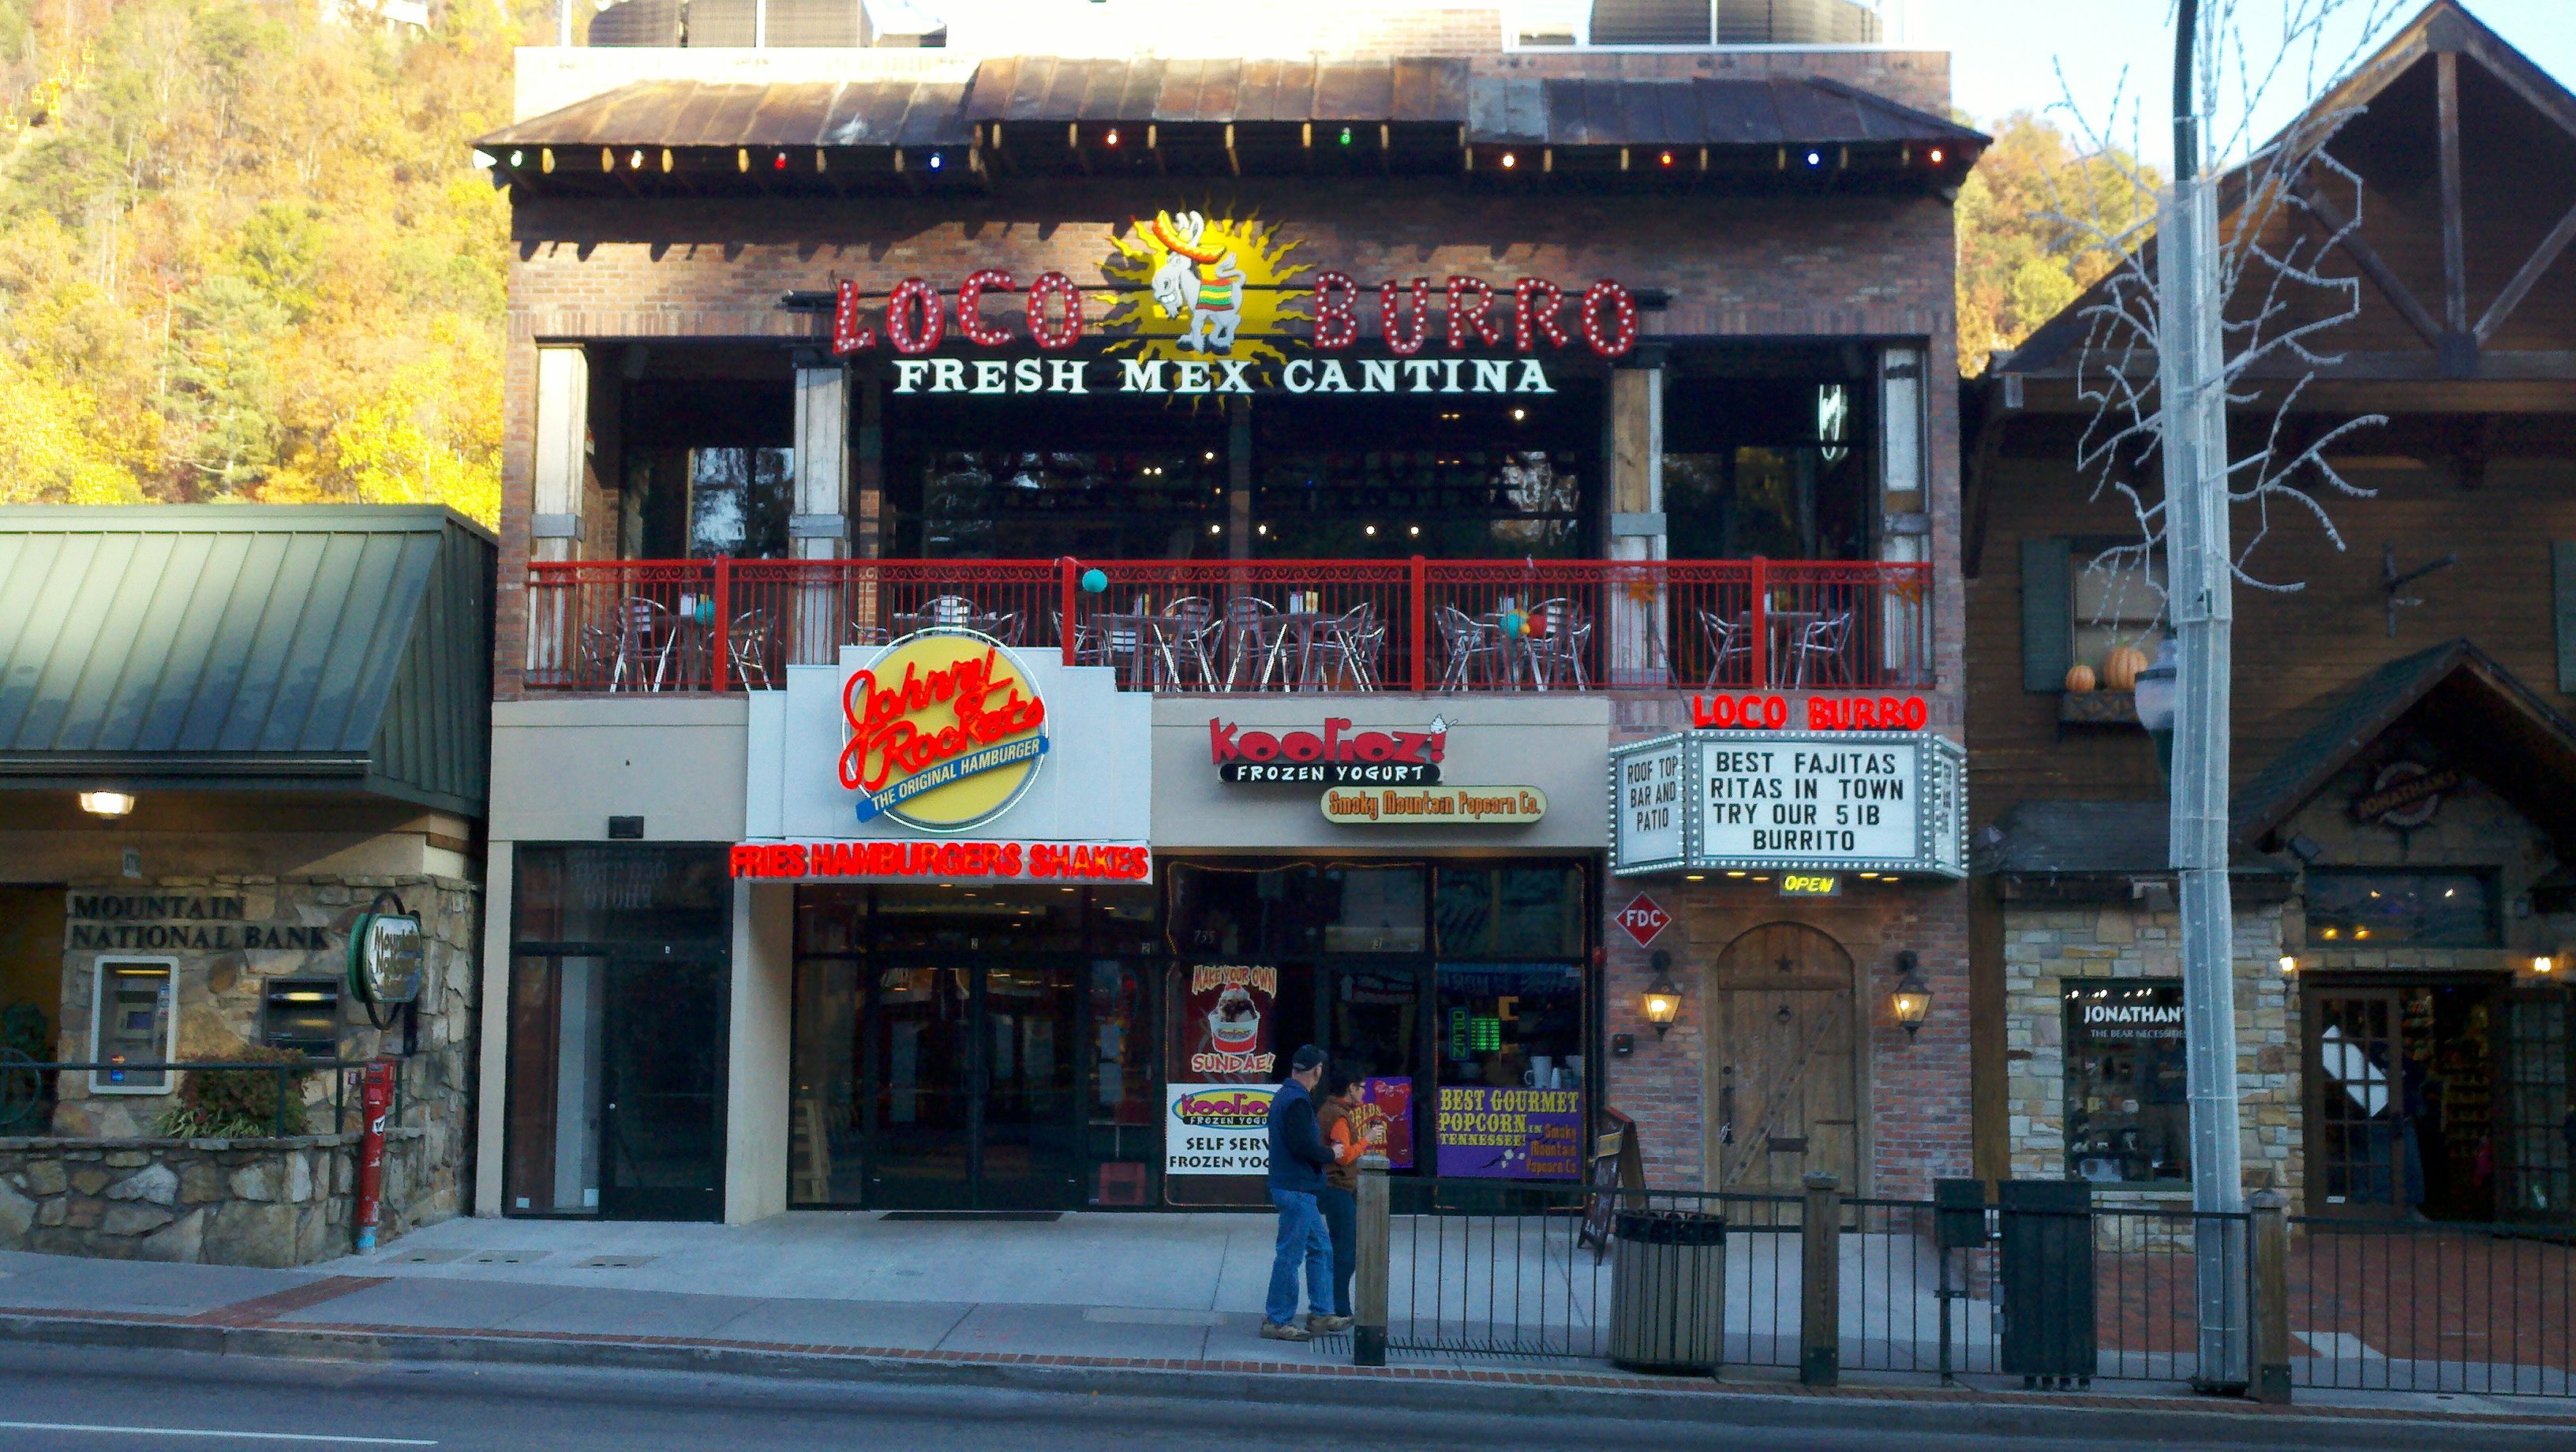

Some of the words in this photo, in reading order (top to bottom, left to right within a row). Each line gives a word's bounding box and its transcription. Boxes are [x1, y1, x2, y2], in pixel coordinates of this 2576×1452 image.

[833, 269, 1080, 355] LOCO
[1314, 270, 1636, 357] BURRO
[892, 360, 1089, 395] FRESH
[1120, 360, 1258, 394] MEX
[1282, 359, 1556, 395] CANTINA
[838, 647, 1013, 789] Johnny
[1693, 694, 1787, 728] LOCO
[1808, 696, 1927, 730] BURRO
[864, 688, 1045, 791] Rockets
[1237, 765, 1324, 781] FROZEN
[1337, 765, 1424, 781] YOGURT
[1627, 756, 1653, 784] ROOF
[1659, 754, 1679, 776] TOP
[1717, 751, 1774, 773] BEST
[1795, 752, 1895, 774] FAJITAS
[871, 788, 896, 811] THE
[899, 766, 957, 798] ORIGINAL
[960, 738, 1039, 776] HAMBURGER
[1631, 786, 1651, 809] BAR
[1655, 781, 1676, 805] AND
[1711, 778, 1782, 799] RITAS
[1795, 779, 1817, 799] IN
[1839, 779, 1904, 800] TOWN
[1329, 791, 1379, 820] Smoky
[1383, 791, 1455, 815] Mountain
[1458, 791, 1516, 819] Popcorn
[1519, 791, 1541, 814] Co.
[1713, 803, 1758, 825] TRY
[1773, 804, 1817, 825] OUR
[1637, 807, 1669, 833] PATIO
[1753, 829, 1855, 851] BURRITO
[729, 844, 807, 878] FRIES
[811, 843, 1023, 876] HAMBURGERS
[1029, 844, 1149, 879] SHAKES
[1783, 875, 1835, 894] OPEN
[74, 895, 246, 920] MOUNTAIN
[1626, 908, 1661, 927] FDC
[73, 925, 236, 948] NATIONAL
[245, 926, 330, 949] BANK
[1192, 964, 1222, 996] MAKE
[1223, 964, 1251, 985] YOUR
[1251, 964, 1277, 999] OWN
[2084, 1005, 2185, 1025] JONATHAN'
[2091, 1029, 2108, 1038] THE
[1191, 1052, 1276, 1073] SUNDAE!
[1440, 1088, 1485, 1111] BEST
[1490, 1089, 1578, 1113] GOURMET
[1240, 1117, 1267, 1125] YOGU
[1440, 1113, 1527, 1133] POPCORN
[1186, 1137, 1225, 1151] SELF
[1230, 1137, 1269, 1151] SERV
[1440, 1133, 1527, 1146] TENNESSEE!
[1170, 1156, 1234, 1168] FROZEN
[1238, 1156, 1269, 1168] YOG
